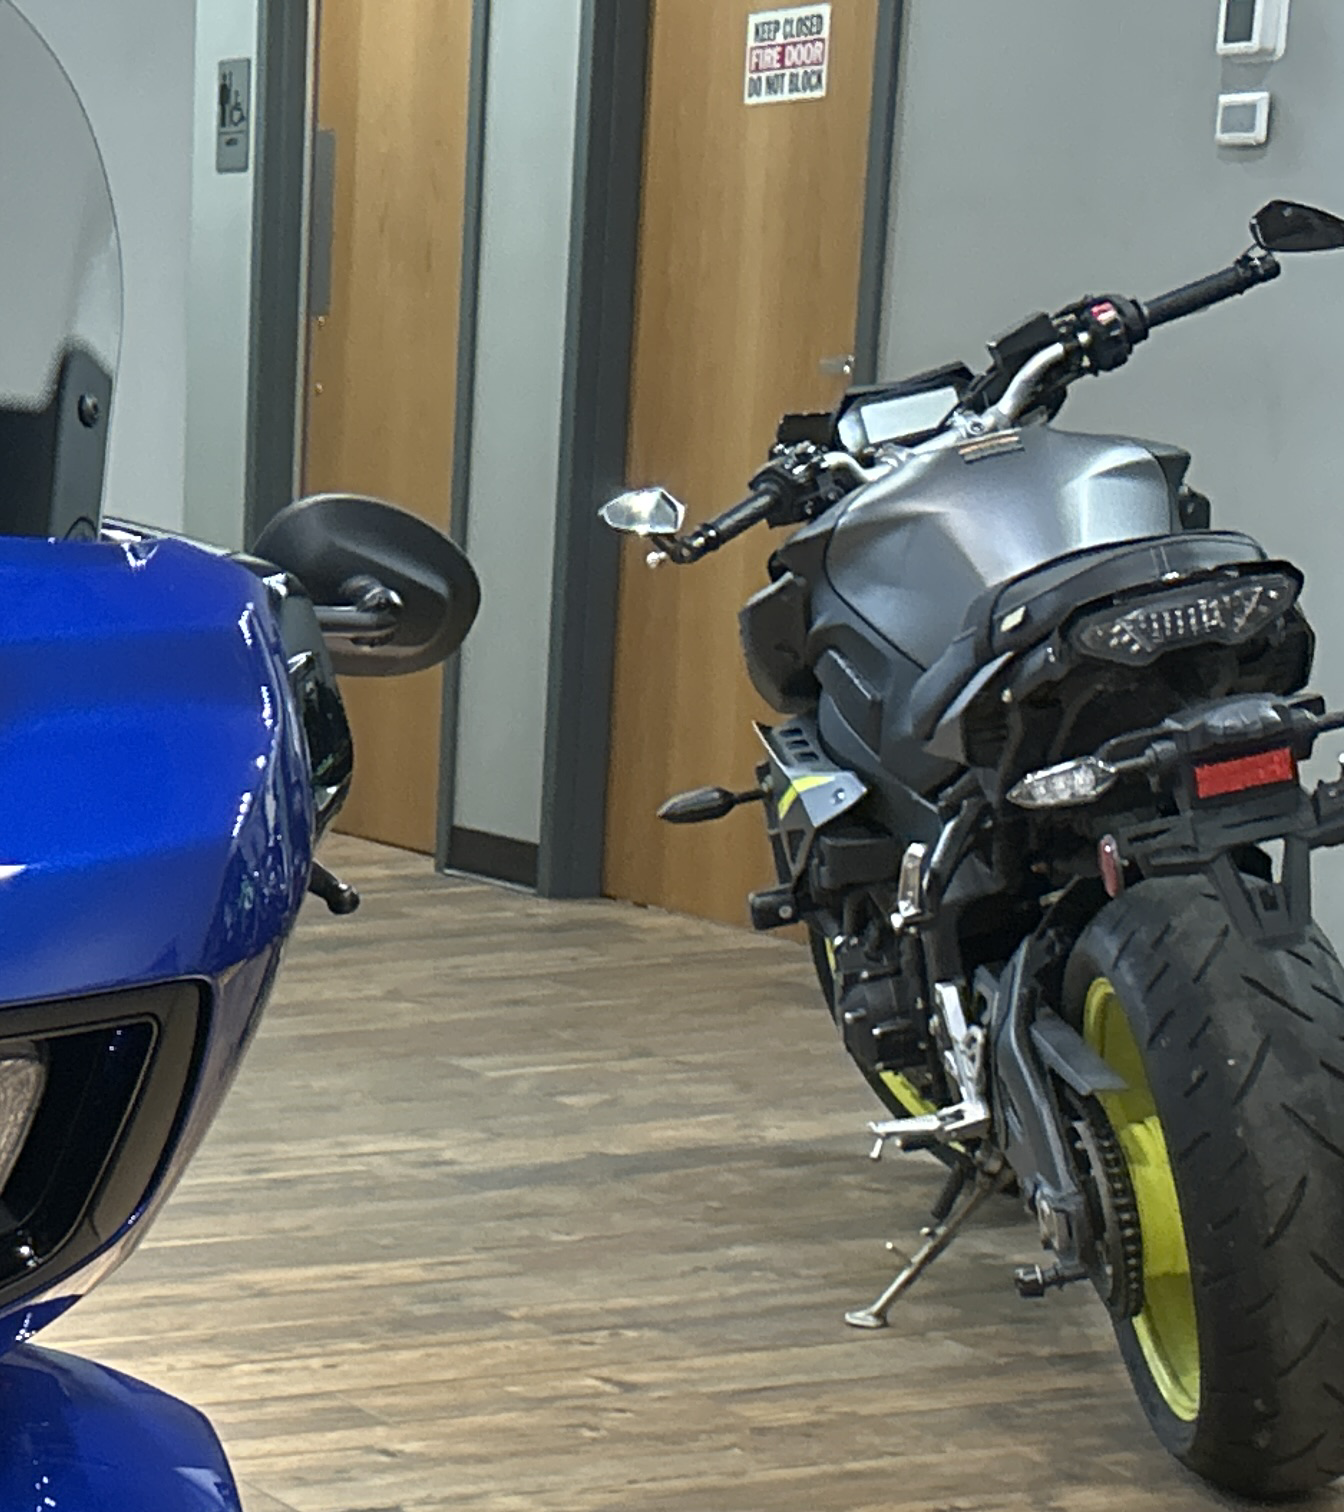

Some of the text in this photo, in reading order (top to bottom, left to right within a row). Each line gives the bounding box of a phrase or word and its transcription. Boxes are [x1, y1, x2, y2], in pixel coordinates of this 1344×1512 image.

[754, 14, 823, 43] KEEP CLOSED
[751, 41, 823, 71] FIRE DOOR
[748, 69, 823, 98] DO NOT BLOCK
